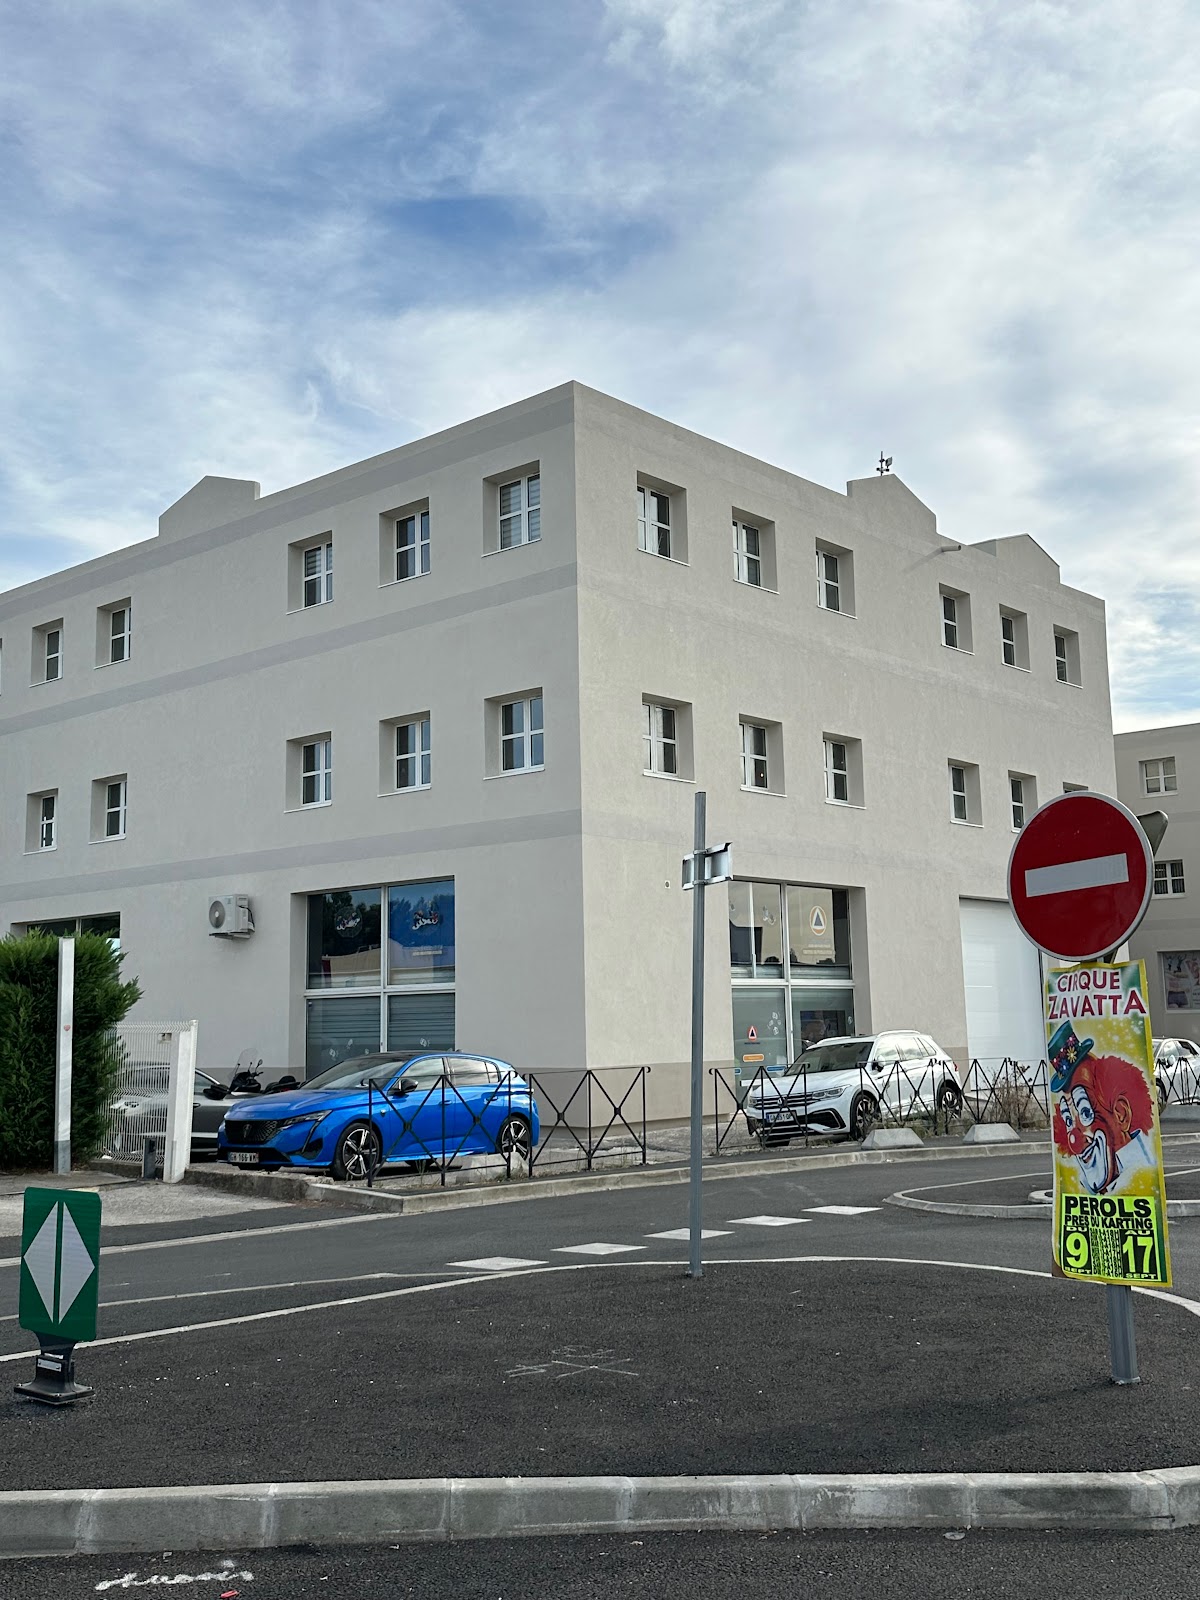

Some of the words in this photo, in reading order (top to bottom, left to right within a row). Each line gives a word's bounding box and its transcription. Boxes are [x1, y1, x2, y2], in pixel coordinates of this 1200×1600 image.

[1057, 970, 1120, 992] CIRQUE
[1048, 989, 1147, 1020] ZAVATTA
[1065, 1196, 1152, 1218] PEROLS
[1065, 1215, 1089, 1226] PRES
[1091, 1217, 1100, 1227] DU
[1102, 1217, 1152, 1229] KARTING
[1065, 1232, 1089, 1268] 9
[1122, 1235, 1154, 1273] 17
